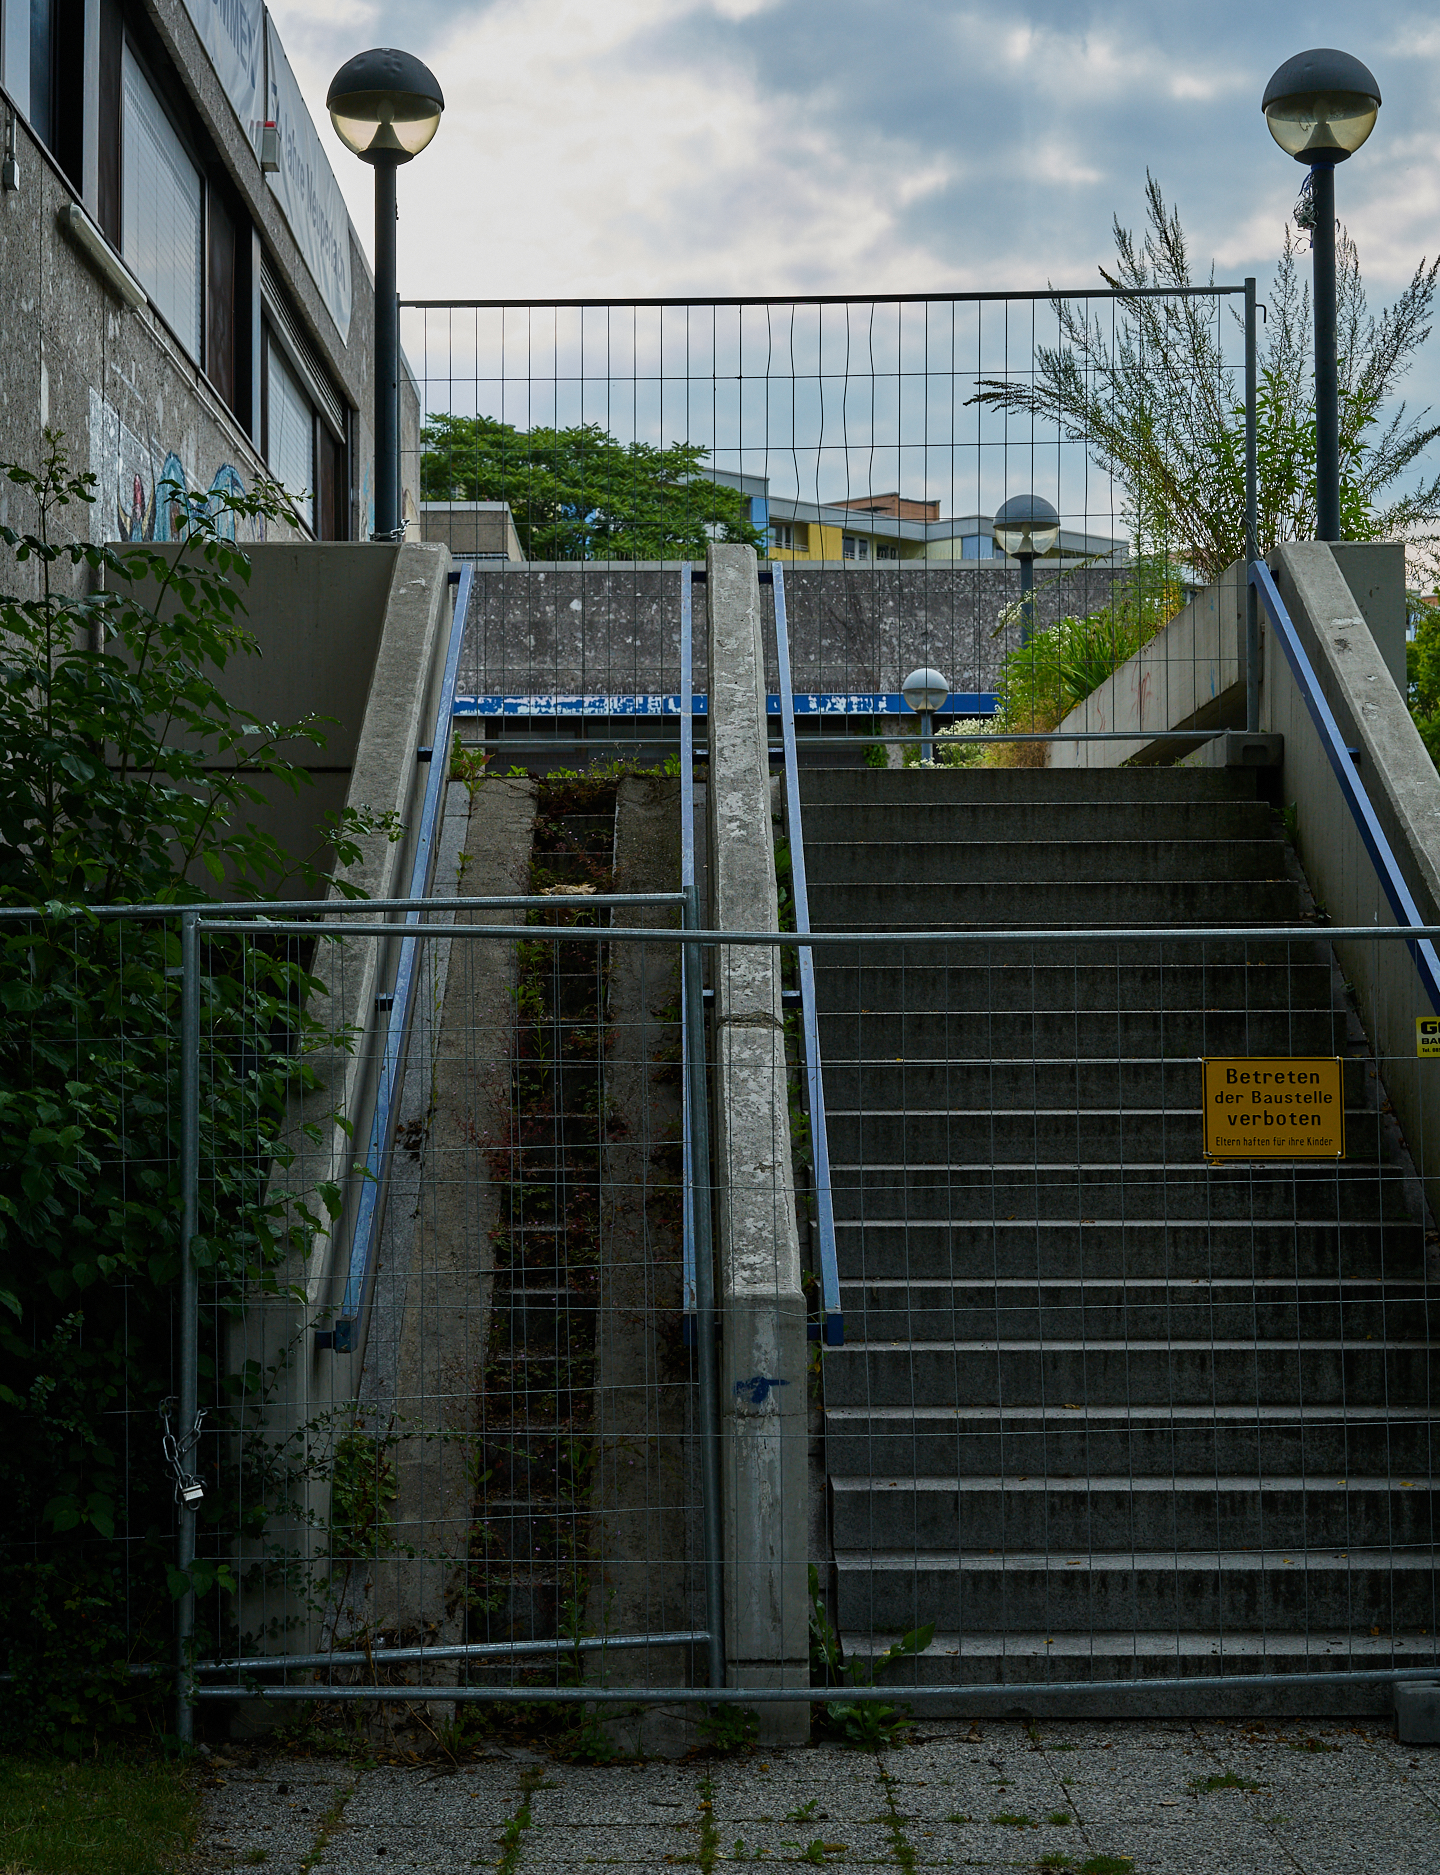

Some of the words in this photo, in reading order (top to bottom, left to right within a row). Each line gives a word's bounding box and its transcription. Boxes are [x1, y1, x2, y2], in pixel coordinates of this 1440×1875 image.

[285, 113, 305, 202] Jahre
[306, 163, 346, 293] Neuperlach
[1420, 1021, 1440, 1035] G
[1226, 1068, 1320, 1084] Betreten
[1214, 1090, 1244, 1104] der
[1251, 1090, 1333, 1104] Baustelle
[1227, 1109, 1321, 1126] verboten
[1215, 1136, 1241, 1146] Eltern
[1243, 1136, 1270, 1146] haften
[1273, 1136, 1286, 1146] für
[1288, 1136, 1304, 1146] ihre
[1306, 1136, 1333, 1146] Kinder
